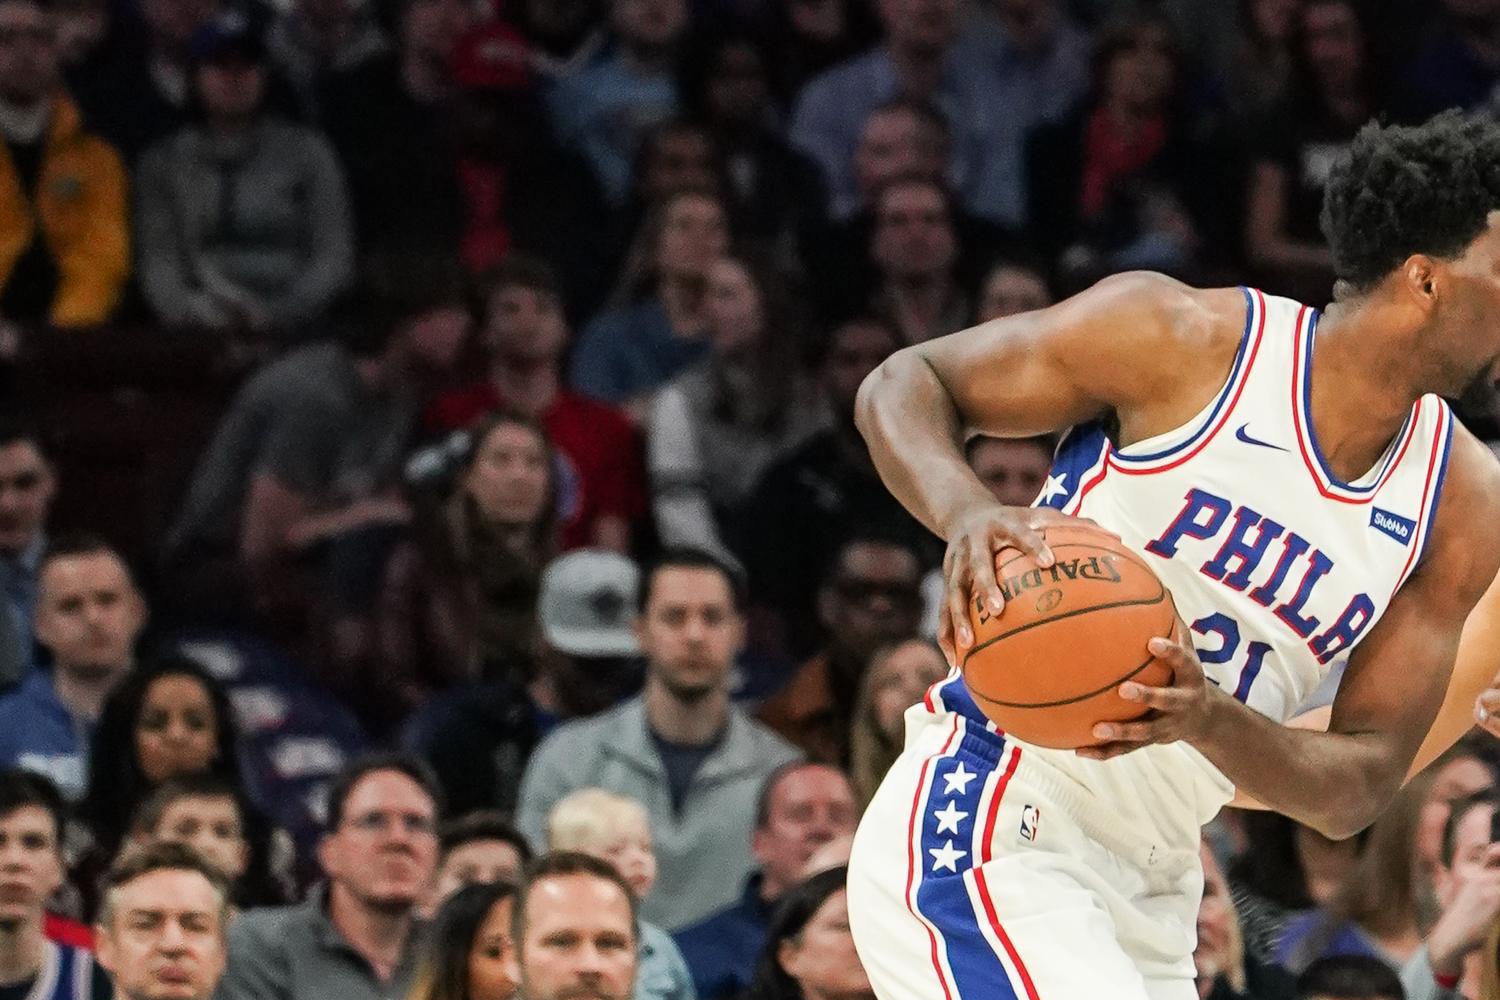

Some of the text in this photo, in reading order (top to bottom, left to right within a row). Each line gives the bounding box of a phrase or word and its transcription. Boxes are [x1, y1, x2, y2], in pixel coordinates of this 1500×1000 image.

[1373, 511, 1409, 538] StubHub
[1144, 487, 1376, 666] PHILA
[1189, 611, 1276, 704] 21
